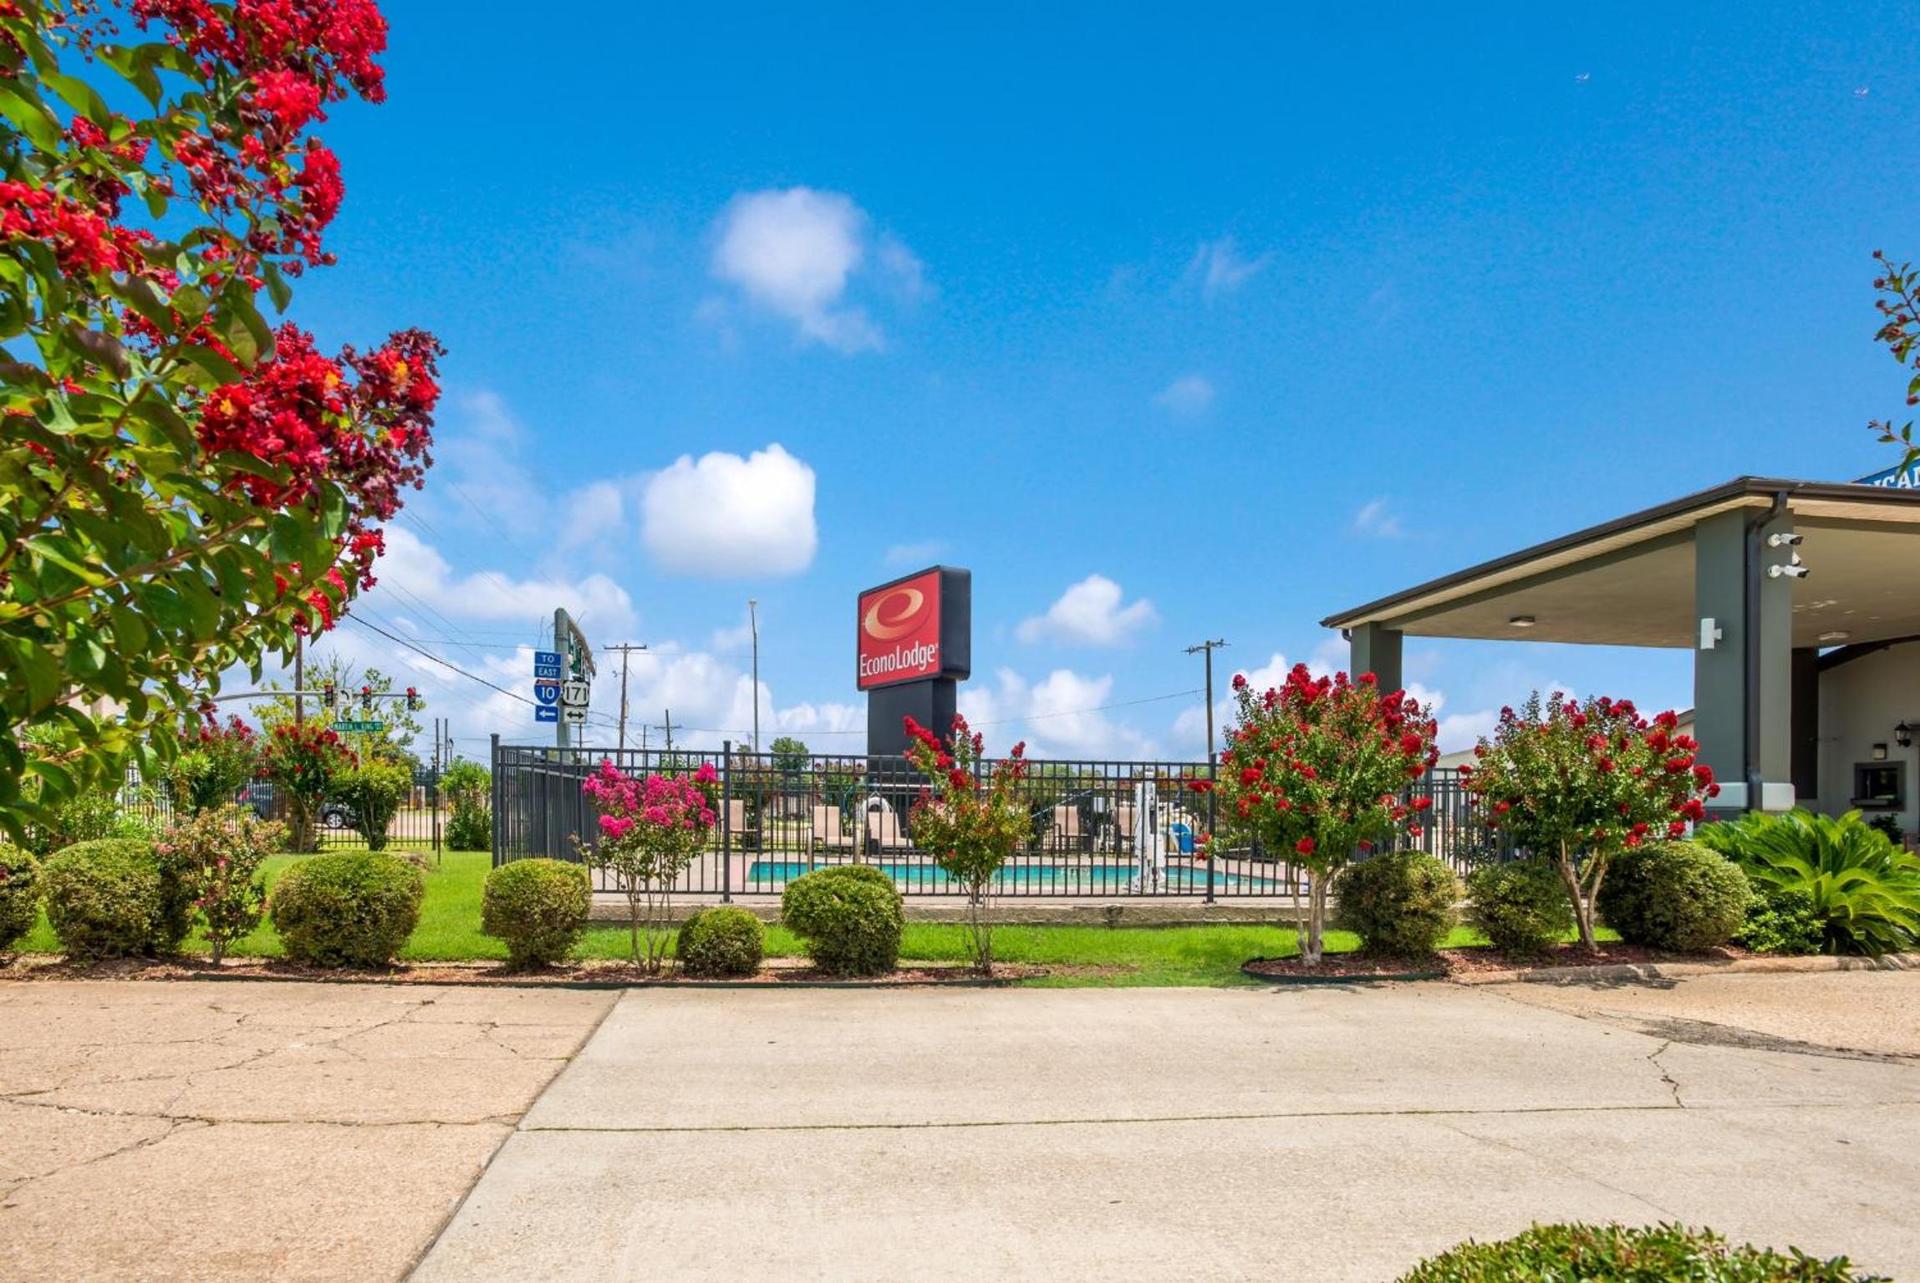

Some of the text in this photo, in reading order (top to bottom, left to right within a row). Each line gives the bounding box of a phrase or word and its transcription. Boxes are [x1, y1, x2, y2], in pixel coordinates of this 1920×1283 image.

[542, 655, 555, 663] TO
[860, 640, 936, 677] EconoLodge
[539, 667, 557, 676] EAST
[541, 687, 555, 699] 10
[566, 686, 587, 701] 171
